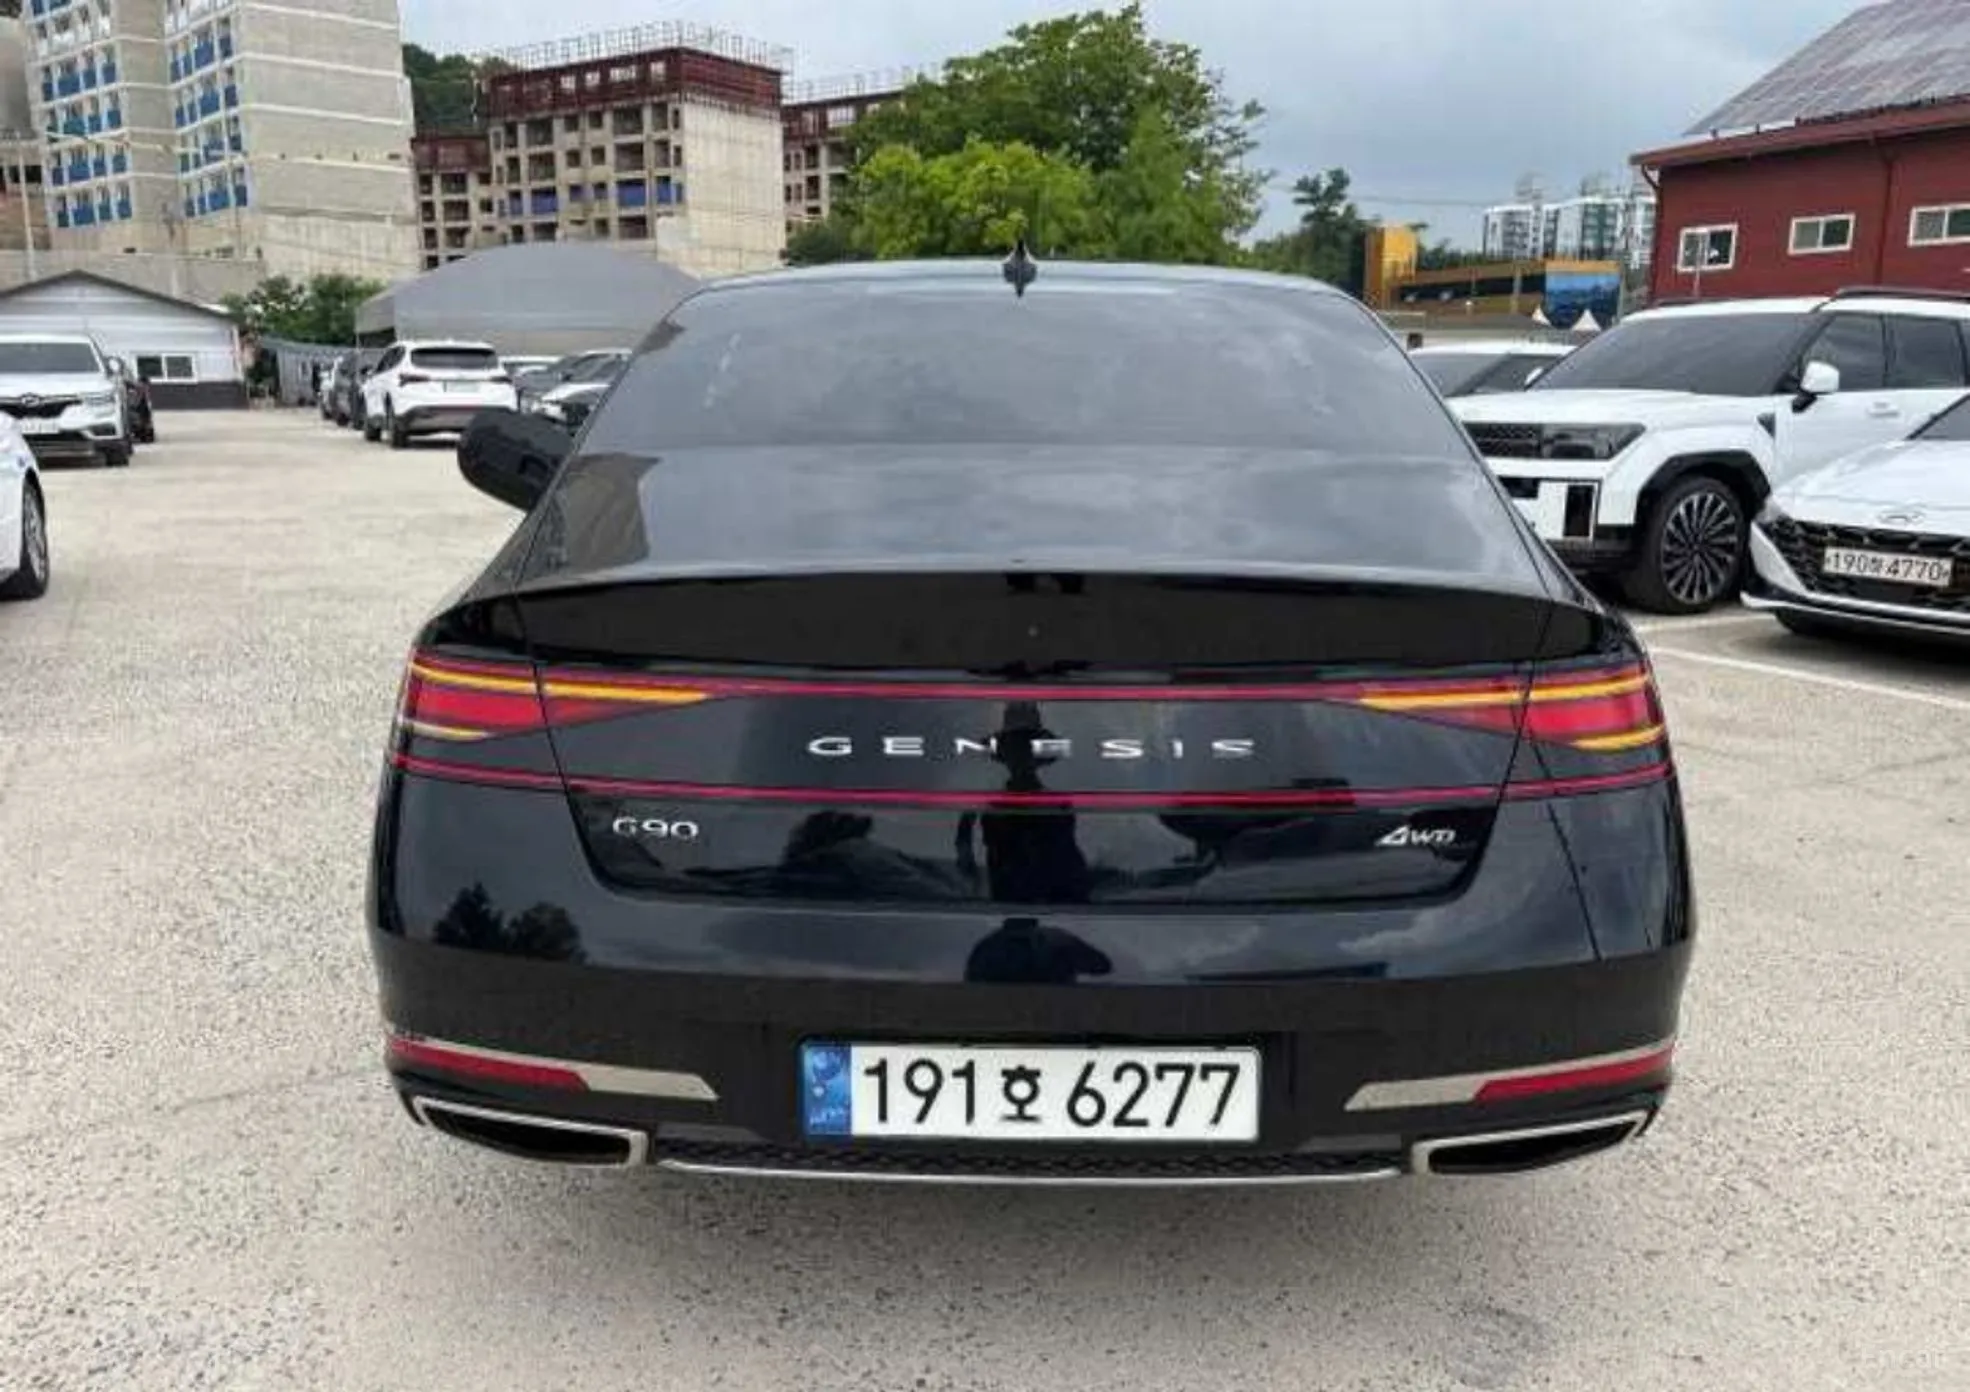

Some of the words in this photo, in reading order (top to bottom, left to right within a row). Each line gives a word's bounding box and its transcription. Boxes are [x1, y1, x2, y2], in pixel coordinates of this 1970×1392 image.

[1886, 558, 1943, 581] 4770
[807, 737, 1255, 759] GENESIS
[612, 816, 699, 839] G90
[1376, 825, 1457, 846] 4WD
[864, 1058, 1042, 1122] 191호
[1066, 1061, 1241, 1127] 6277
